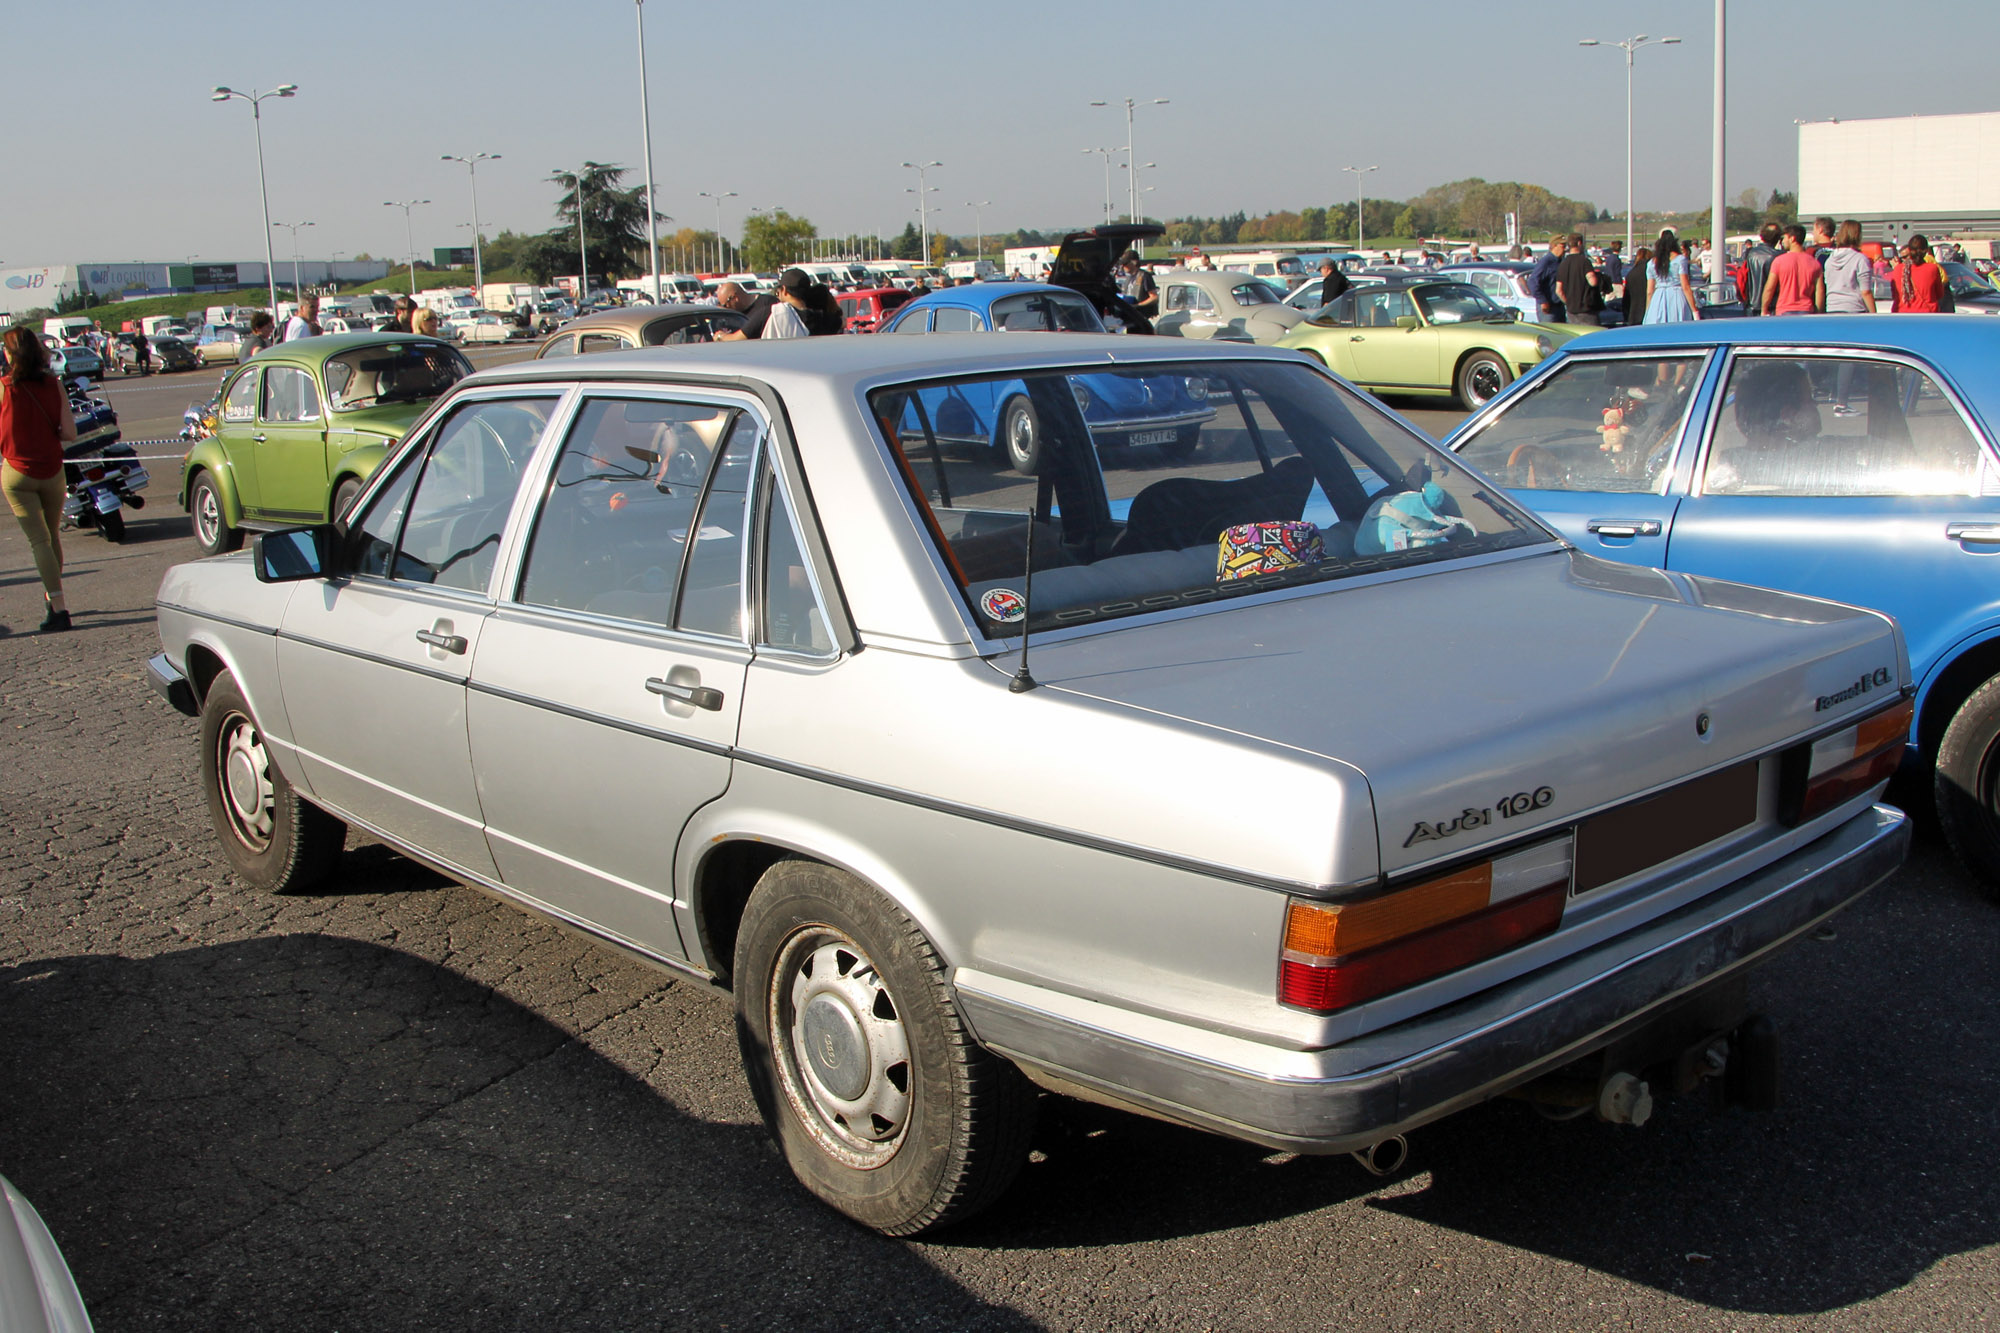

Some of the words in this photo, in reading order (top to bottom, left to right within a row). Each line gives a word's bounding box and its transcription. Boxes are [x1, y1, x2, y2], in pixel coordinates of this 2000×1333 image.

[111, 271, 156, 284] LOGISTICS
[1403, 807, 1492, 848] Audi
[1497, 785, 1556, 819] 100
